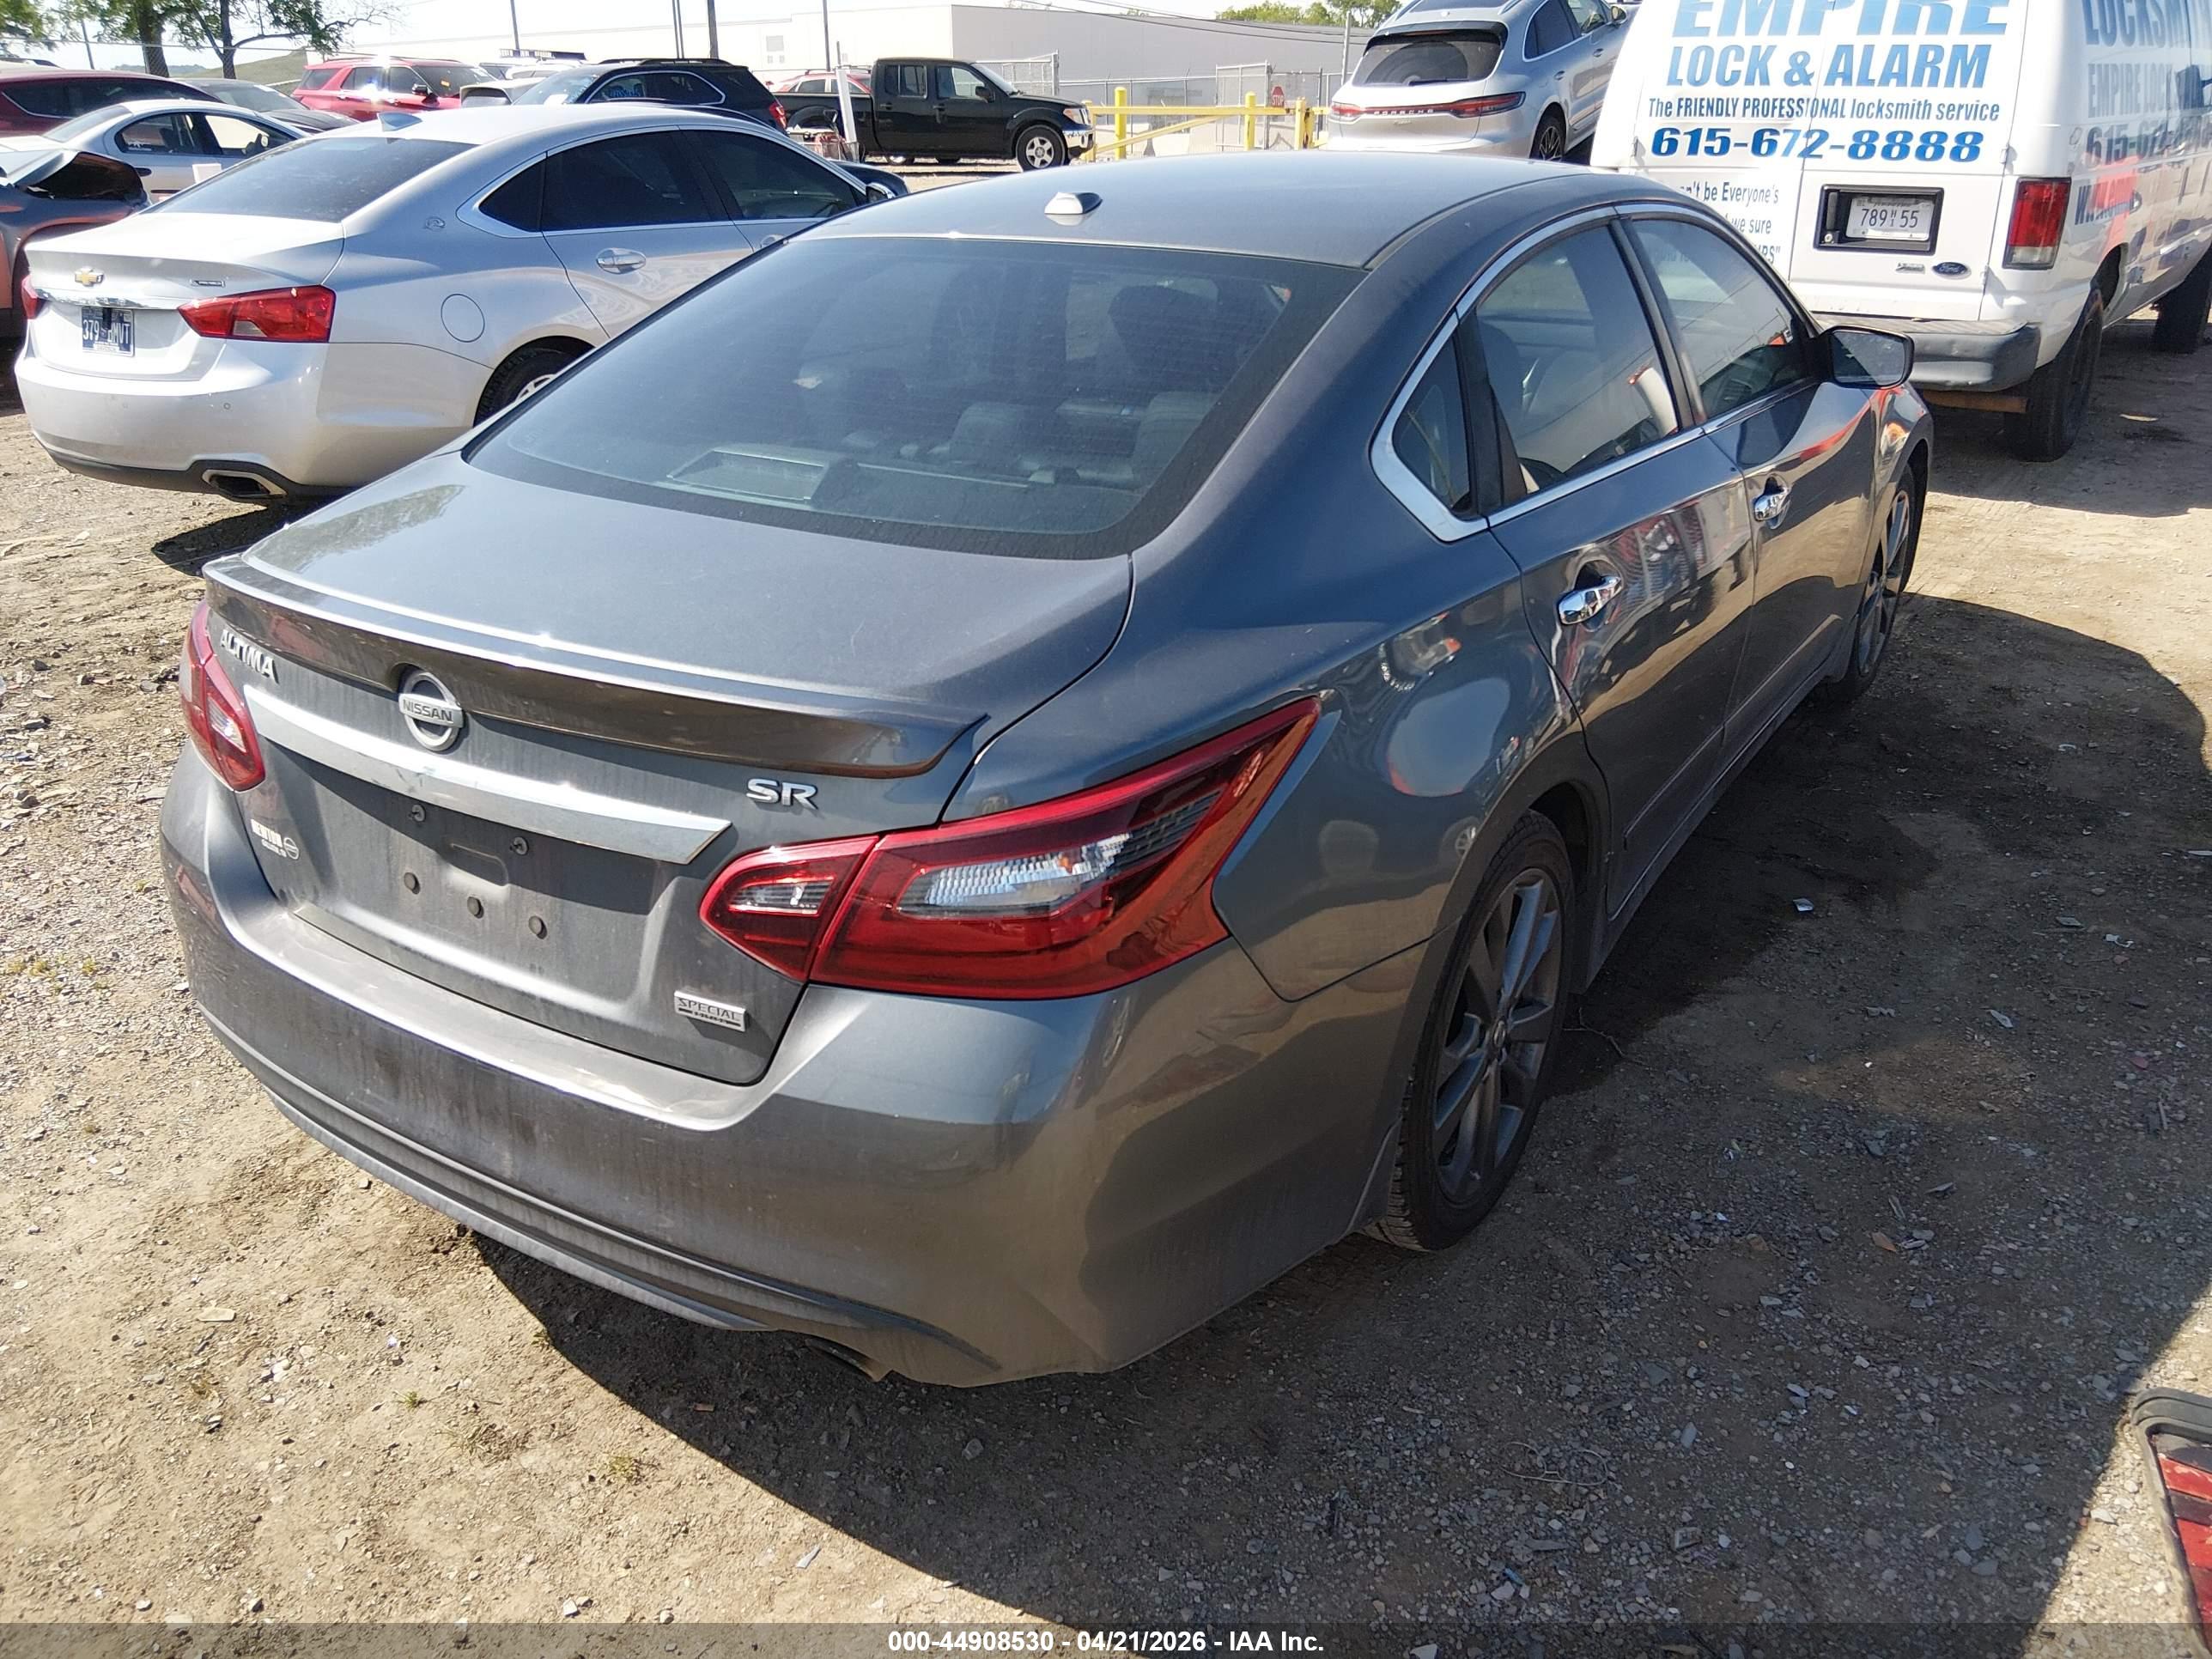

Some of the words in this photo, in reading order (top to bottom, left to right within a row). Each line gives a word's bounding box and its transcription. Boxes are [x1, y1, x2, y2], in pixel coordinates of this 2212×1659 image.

[1672, 0, 2009, 37] EMPIRE
[1667, 45, 1777, 87] LOCK
[1784, 51, 1814, 87] &
[1824, 44, 1991, 88] ALARM
[1649, 98, 1673, 118] The
[1676, 98, 1739, 118] FRIENDLY
[1742, 98, 1845, 118] PROFESSIONAL
[1850, 98, 1932, 120] locksmith
[1936, 100, 2000, 121] service
[1651, 128, 1984, 162] 615-672-8888
[1704, 181, 1717, 201] be
[1722, 182, 1779, 207] Everyone's
[1748, 219, 1771, 234] sure
[1861, 209, 1888, 227] 789
[83, 319, 100, 341] 379
[220, 629, 277, 681] ALTIMA
[403, 699, 453, 722] NISSAN
[746, 779, 818, 810] SR
[678, 999, 741, 1022] SPECIAL
